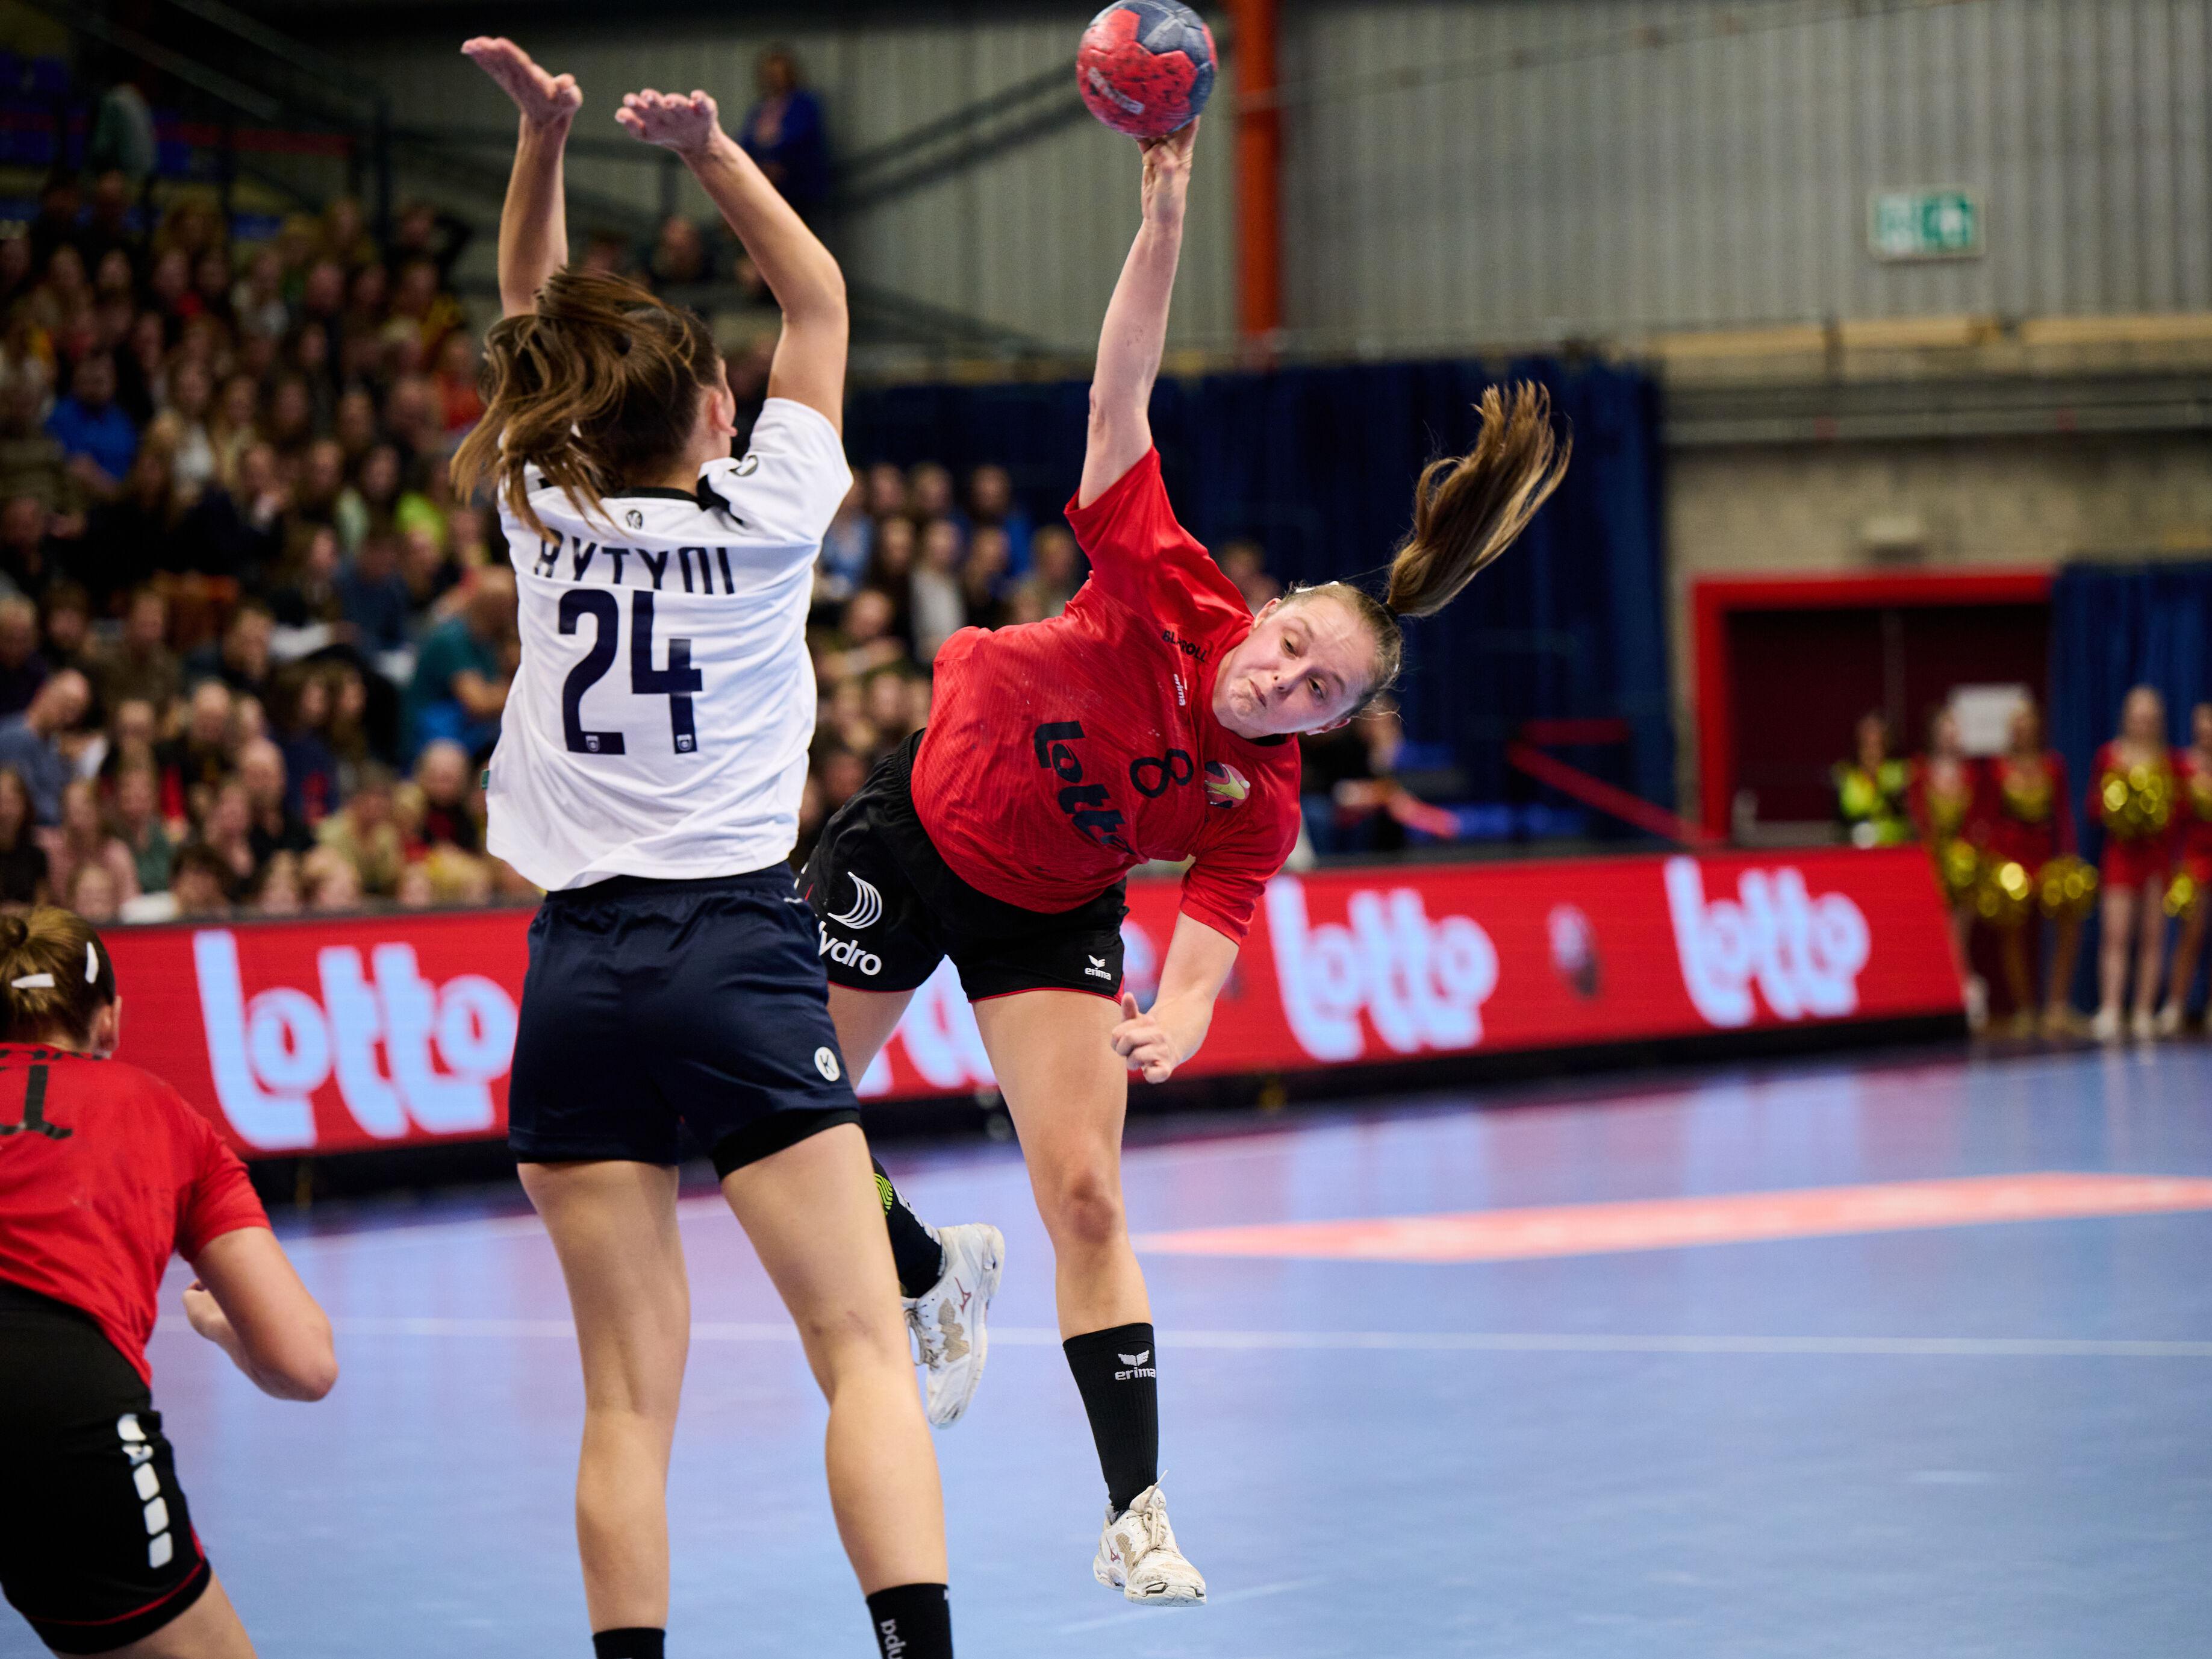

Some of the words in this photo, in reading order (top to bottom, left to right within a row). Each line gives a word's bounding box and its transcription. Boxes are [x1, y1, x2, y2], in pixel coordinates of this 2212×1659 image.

[559, 589, 703, 755] 24
[1130, 749, 1194, 798] 8
[818, 920, 882, 976] ydro
[1085, 967, 1112, 981] erima
[1115, 1366, 1156, 1381] erima
